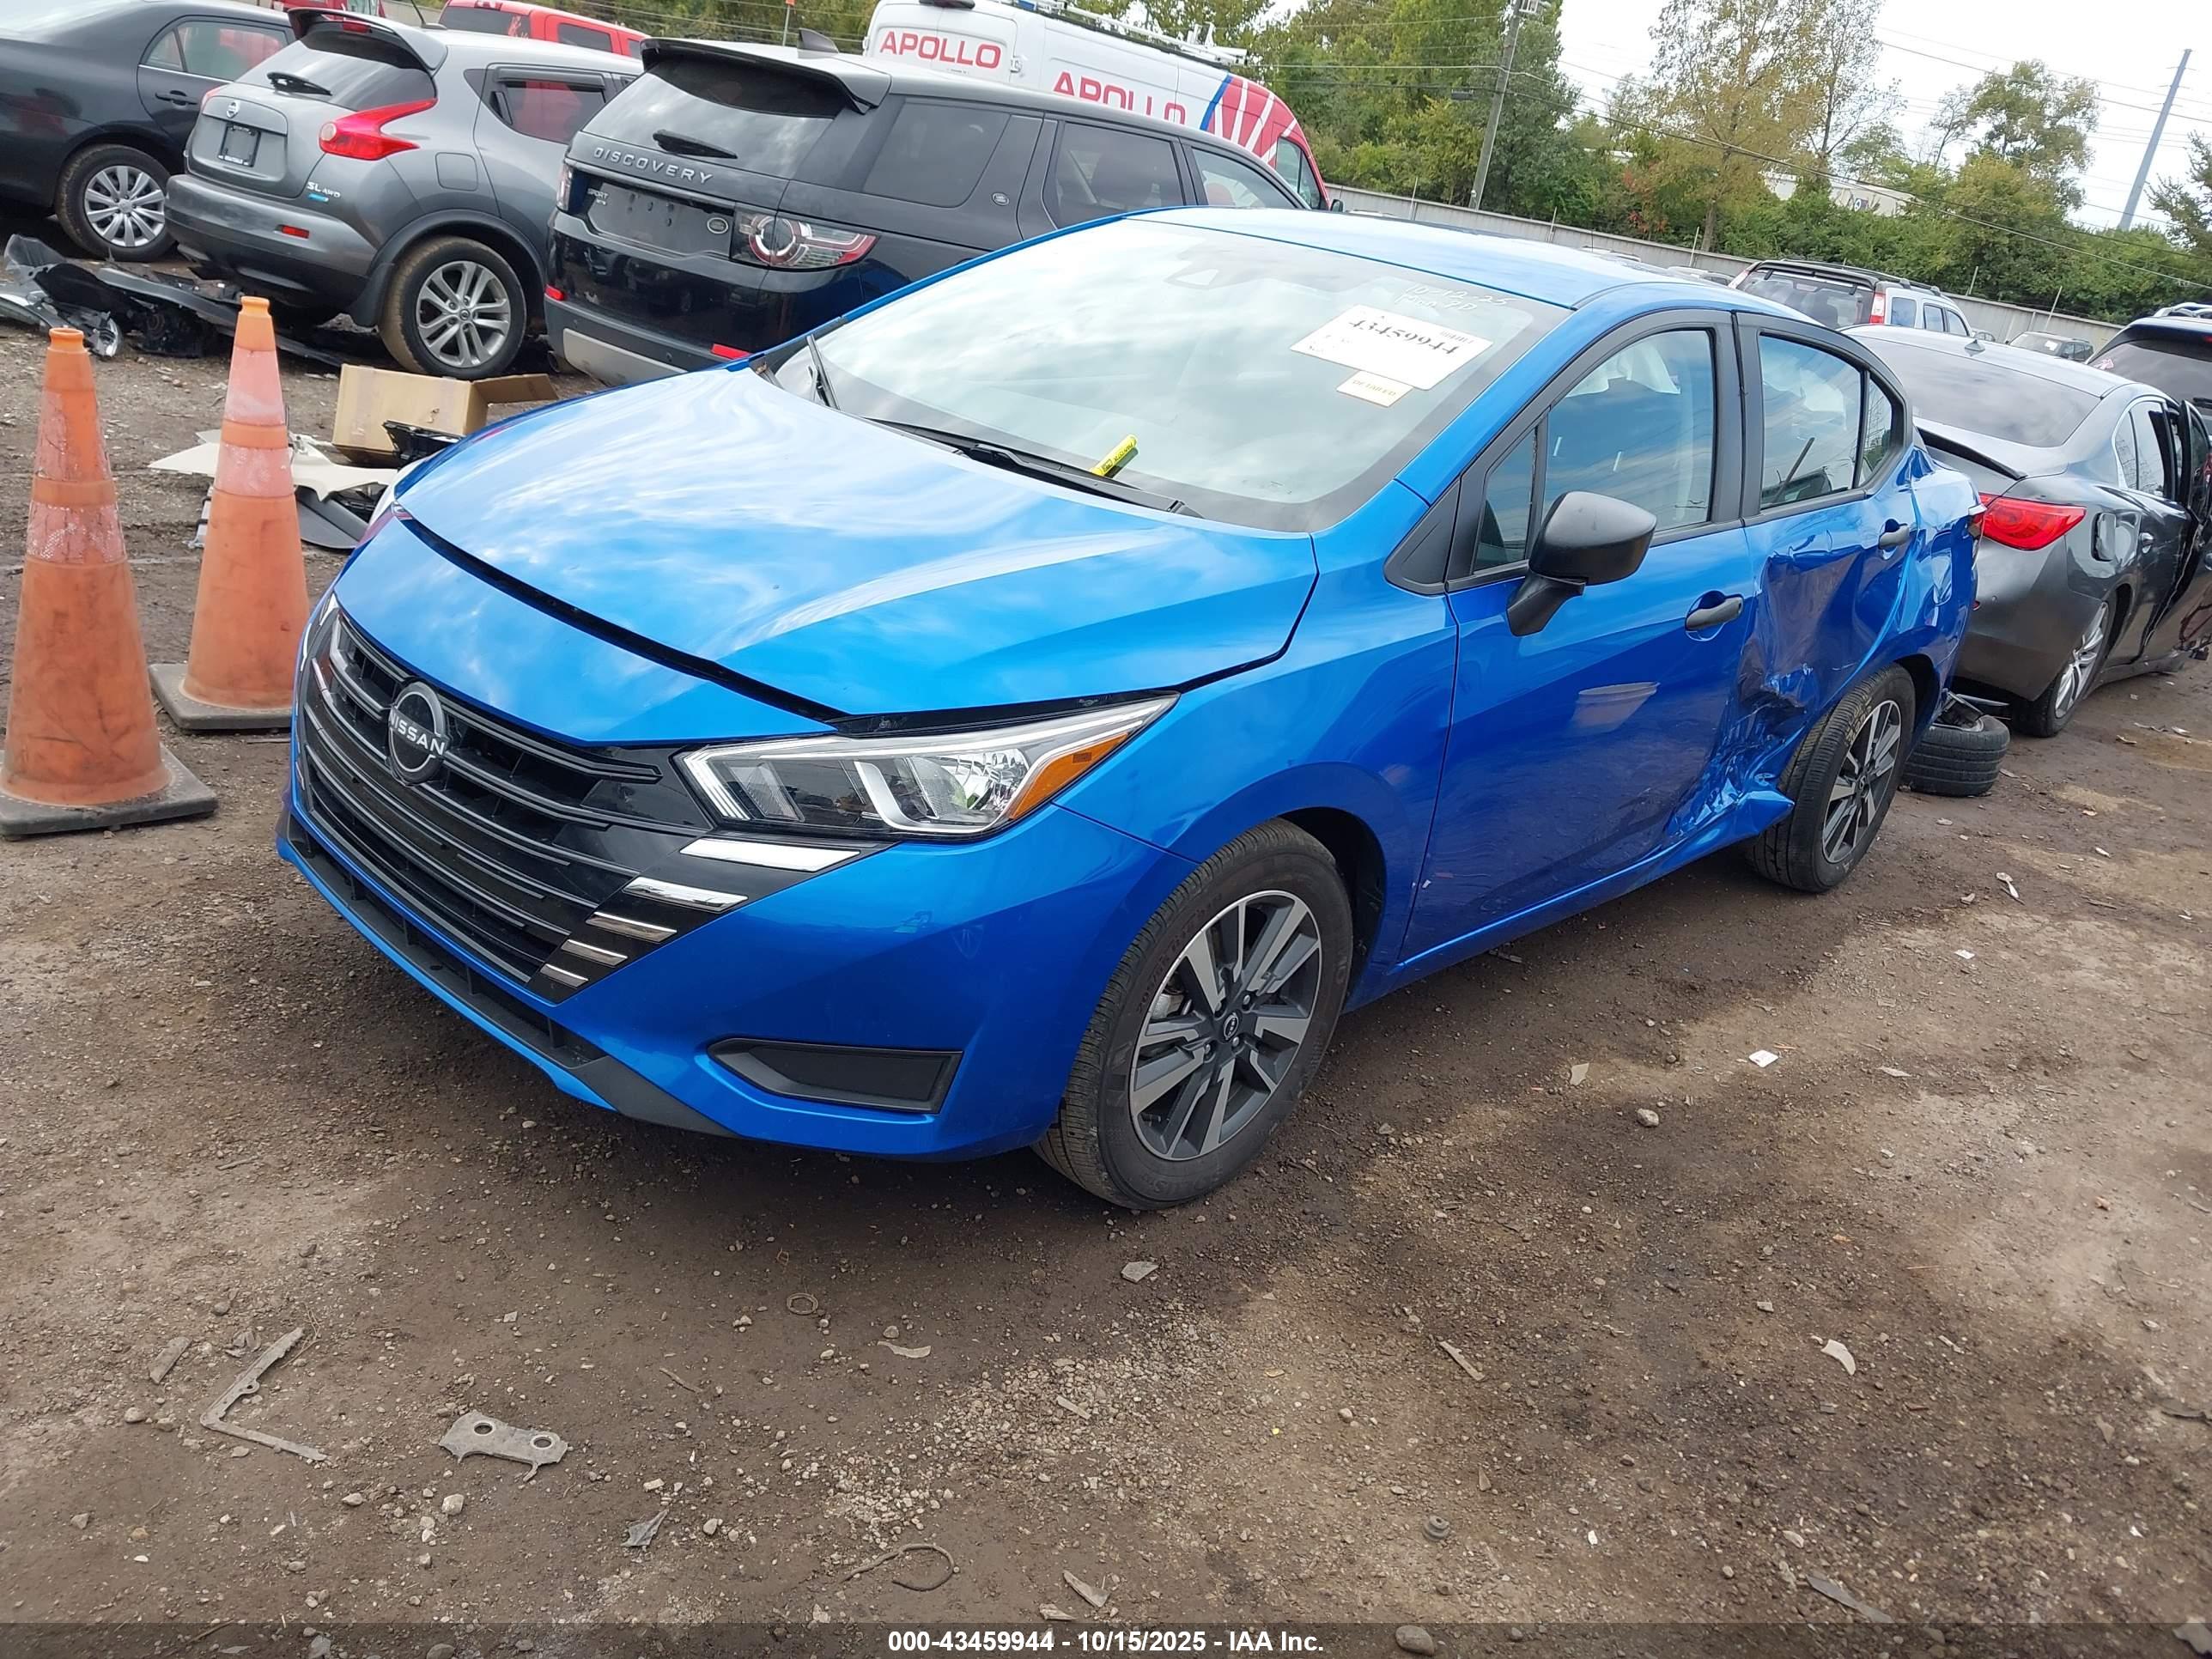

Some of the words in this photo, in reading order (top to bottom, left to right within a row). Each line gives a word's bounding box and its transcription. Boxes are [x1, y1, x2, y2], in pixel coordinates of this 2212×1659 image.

[879, 31, 1001, 70] APOLLO
[593, 147, 713, 184] DISCOVERY
[307, 181, 321, 192] SL
[1348, 319, 1460, 355] 43459944
[390, 708, 446, 756] NISSAN
